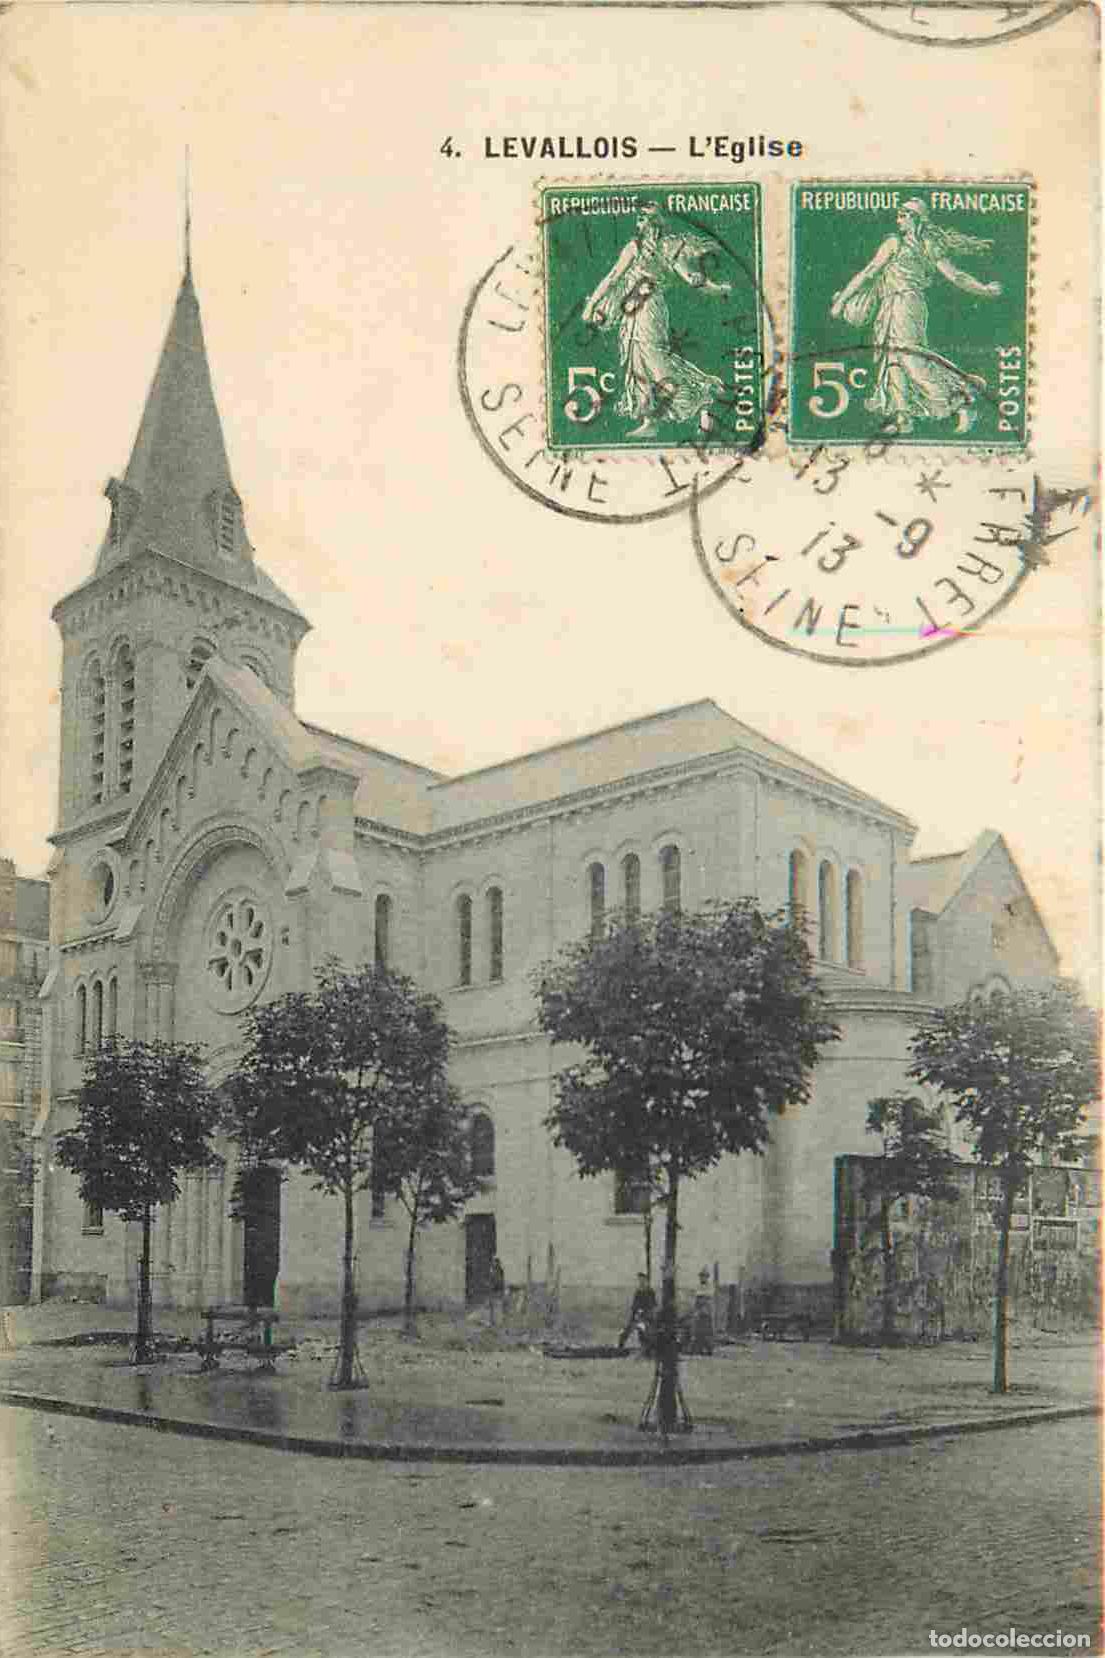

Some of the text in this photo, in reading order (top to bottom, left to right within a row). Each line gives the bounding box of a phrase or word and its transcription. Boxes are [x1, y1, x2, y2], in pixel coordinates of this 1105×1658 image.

[668, 193, 751, 214] FRANÇAISE
[931, 192, 1026, 213] FRANÇAISE
[733, 346, 756, 433] POSTES
[998, 345, 1023, 432] POSTES
